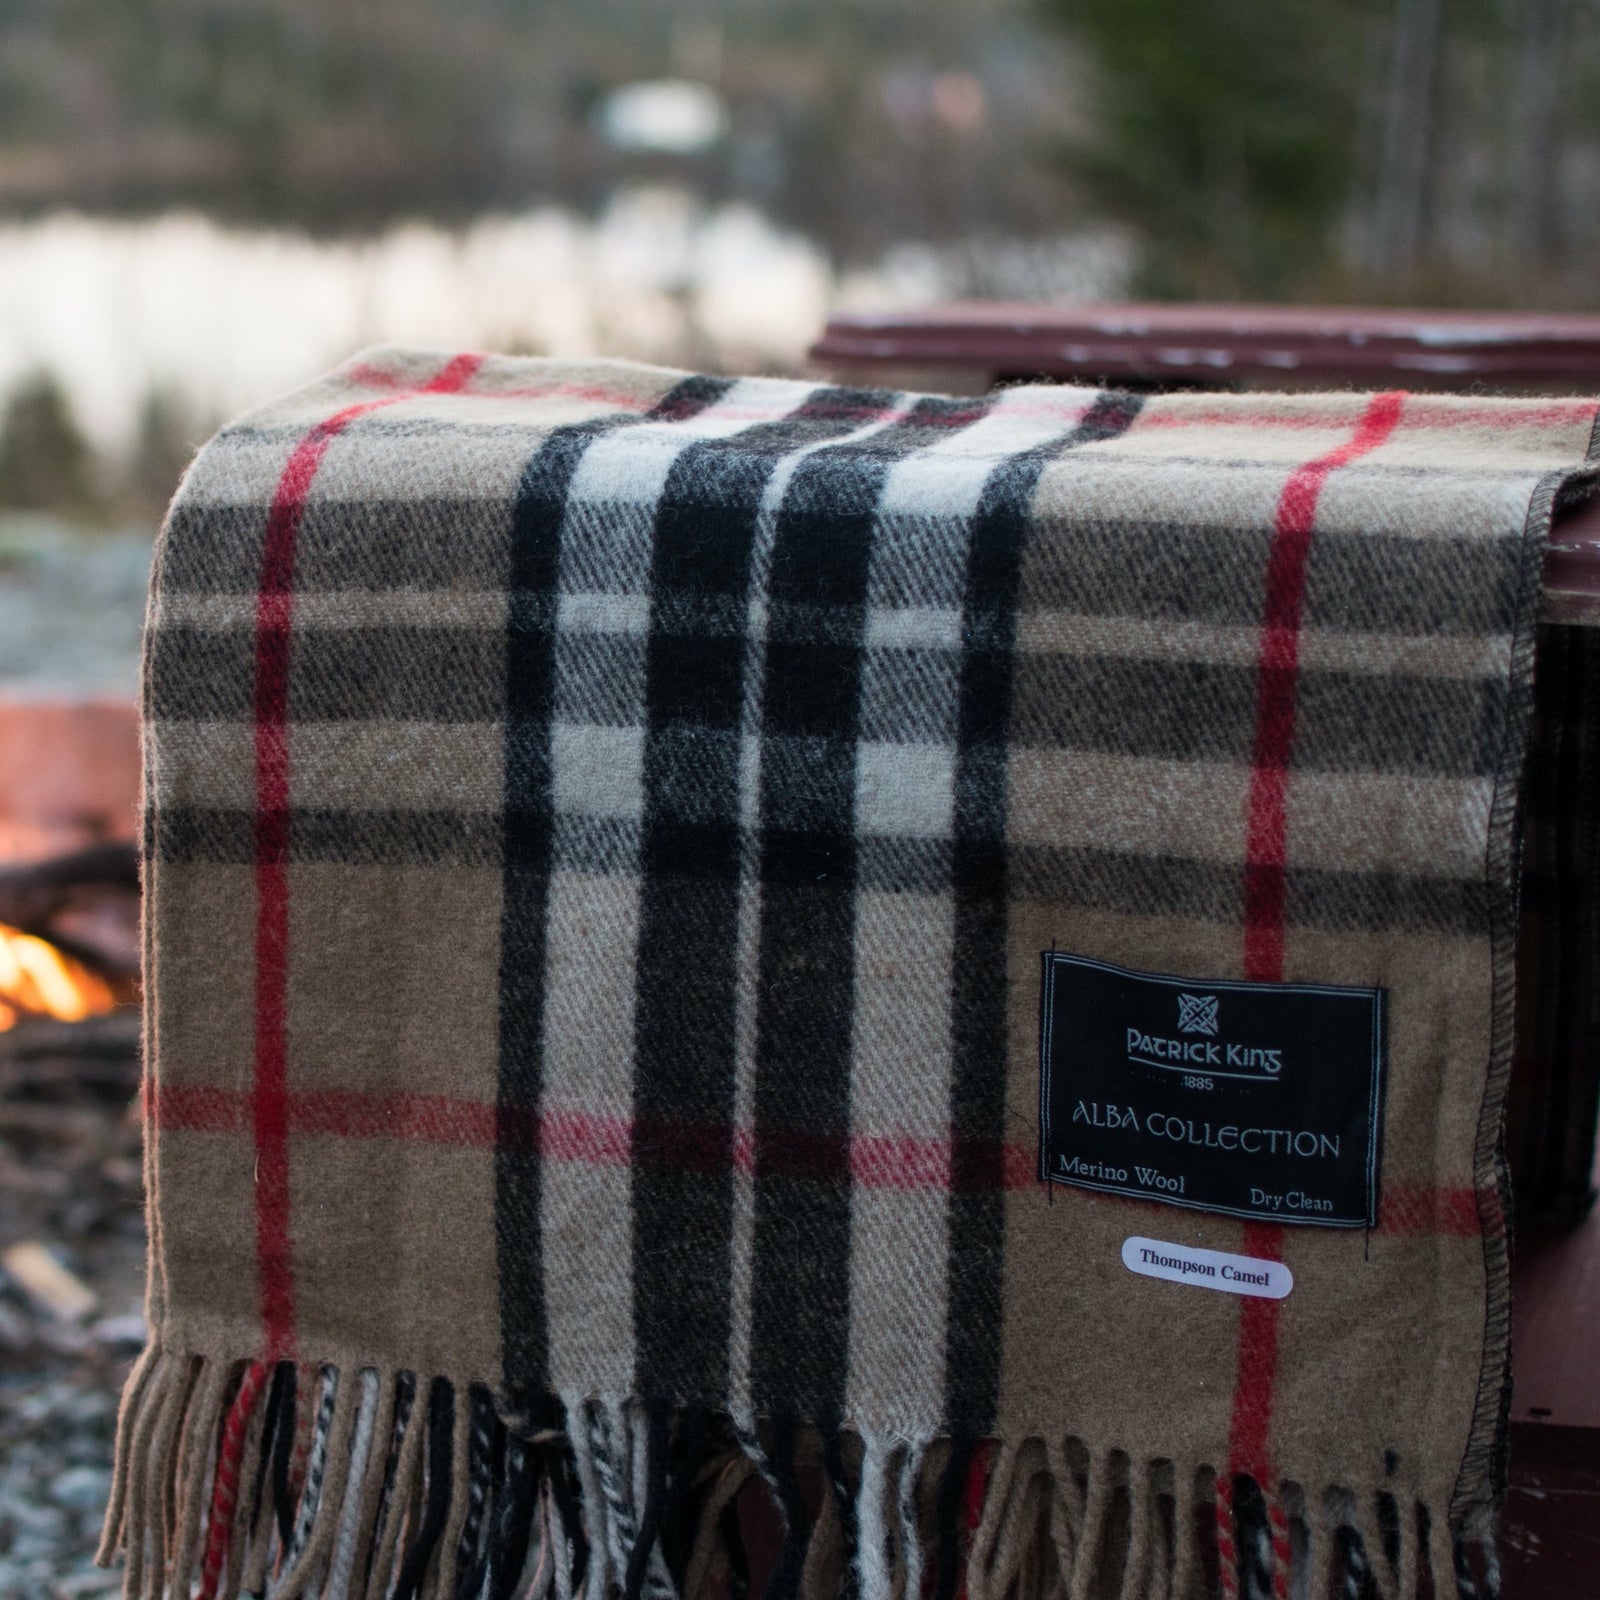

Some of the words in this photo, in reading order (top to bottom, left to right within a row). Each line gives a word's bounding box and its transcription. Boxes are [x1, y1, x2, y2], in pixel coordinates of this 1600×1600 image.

[1127, 1027, 1221, 1064] PATRICK
[1183, 1075, 1214, 1091] 1885
[1072, 1100, 1140, 1131] ALBA
[1146, 1113, 1340, 1157] COLLECTION
[1059, 1154, 1128, 1181] Merino
[1134, 1166, 1186, 1193] Wool
[1250, 1188, 1283, 1209] Dry
[1286, 1194, 1333, 1211] Clean
[1140, 1248, 1216, 1277] Thompson
[1220, 1265, 1270, 1287] Camel
